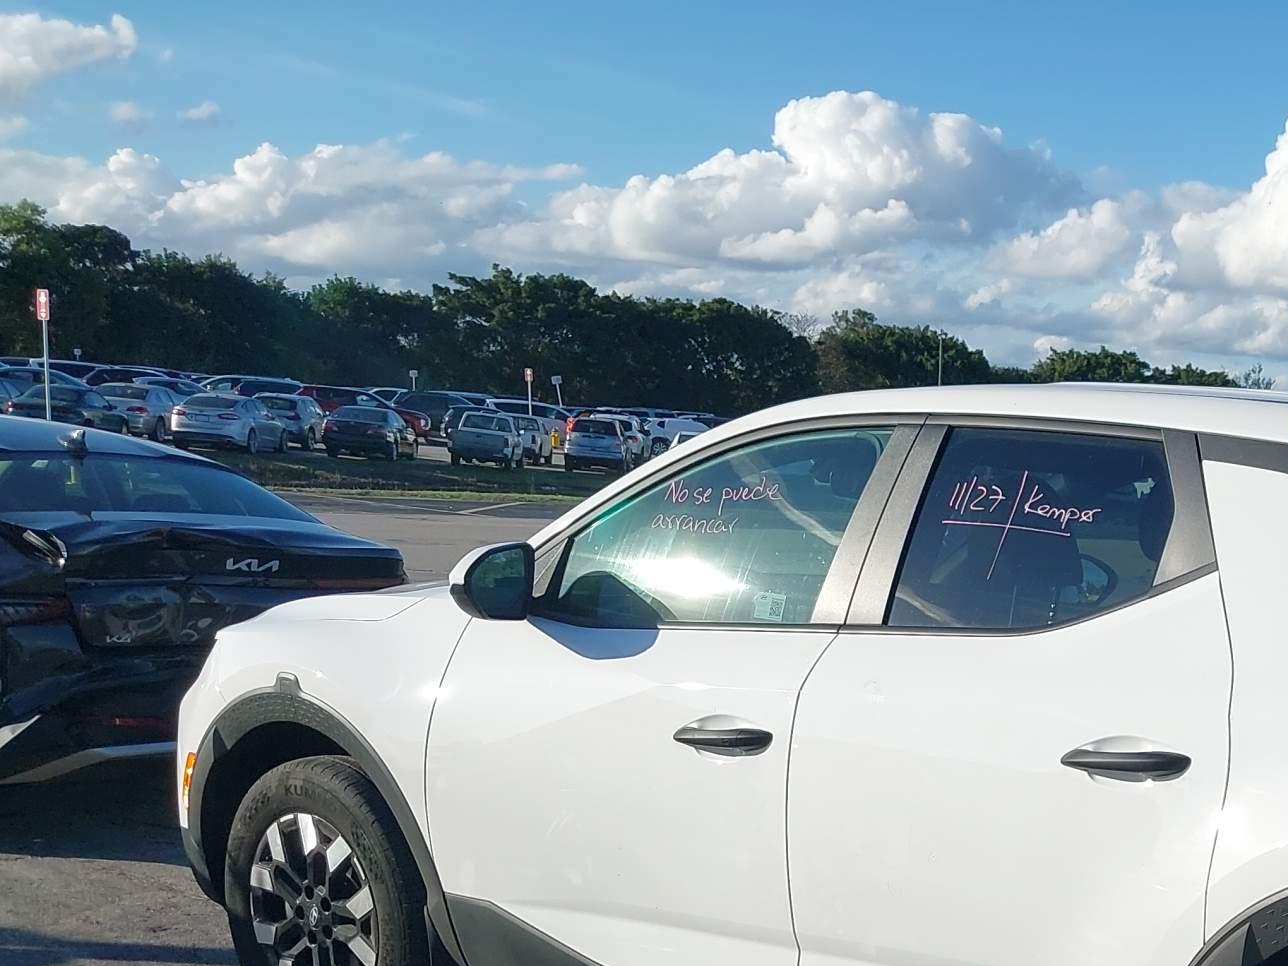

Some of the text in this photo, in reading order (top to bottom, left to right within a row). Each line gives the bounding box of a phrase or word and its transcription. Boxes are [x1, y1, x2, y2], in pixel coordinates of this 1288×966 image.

[664, 470, 785, 516] No se puede
[949, 476, 1006, 515] 11/27
[651, 513, 739, 535] arrancar
[225, 557, 280, 573] KIA
